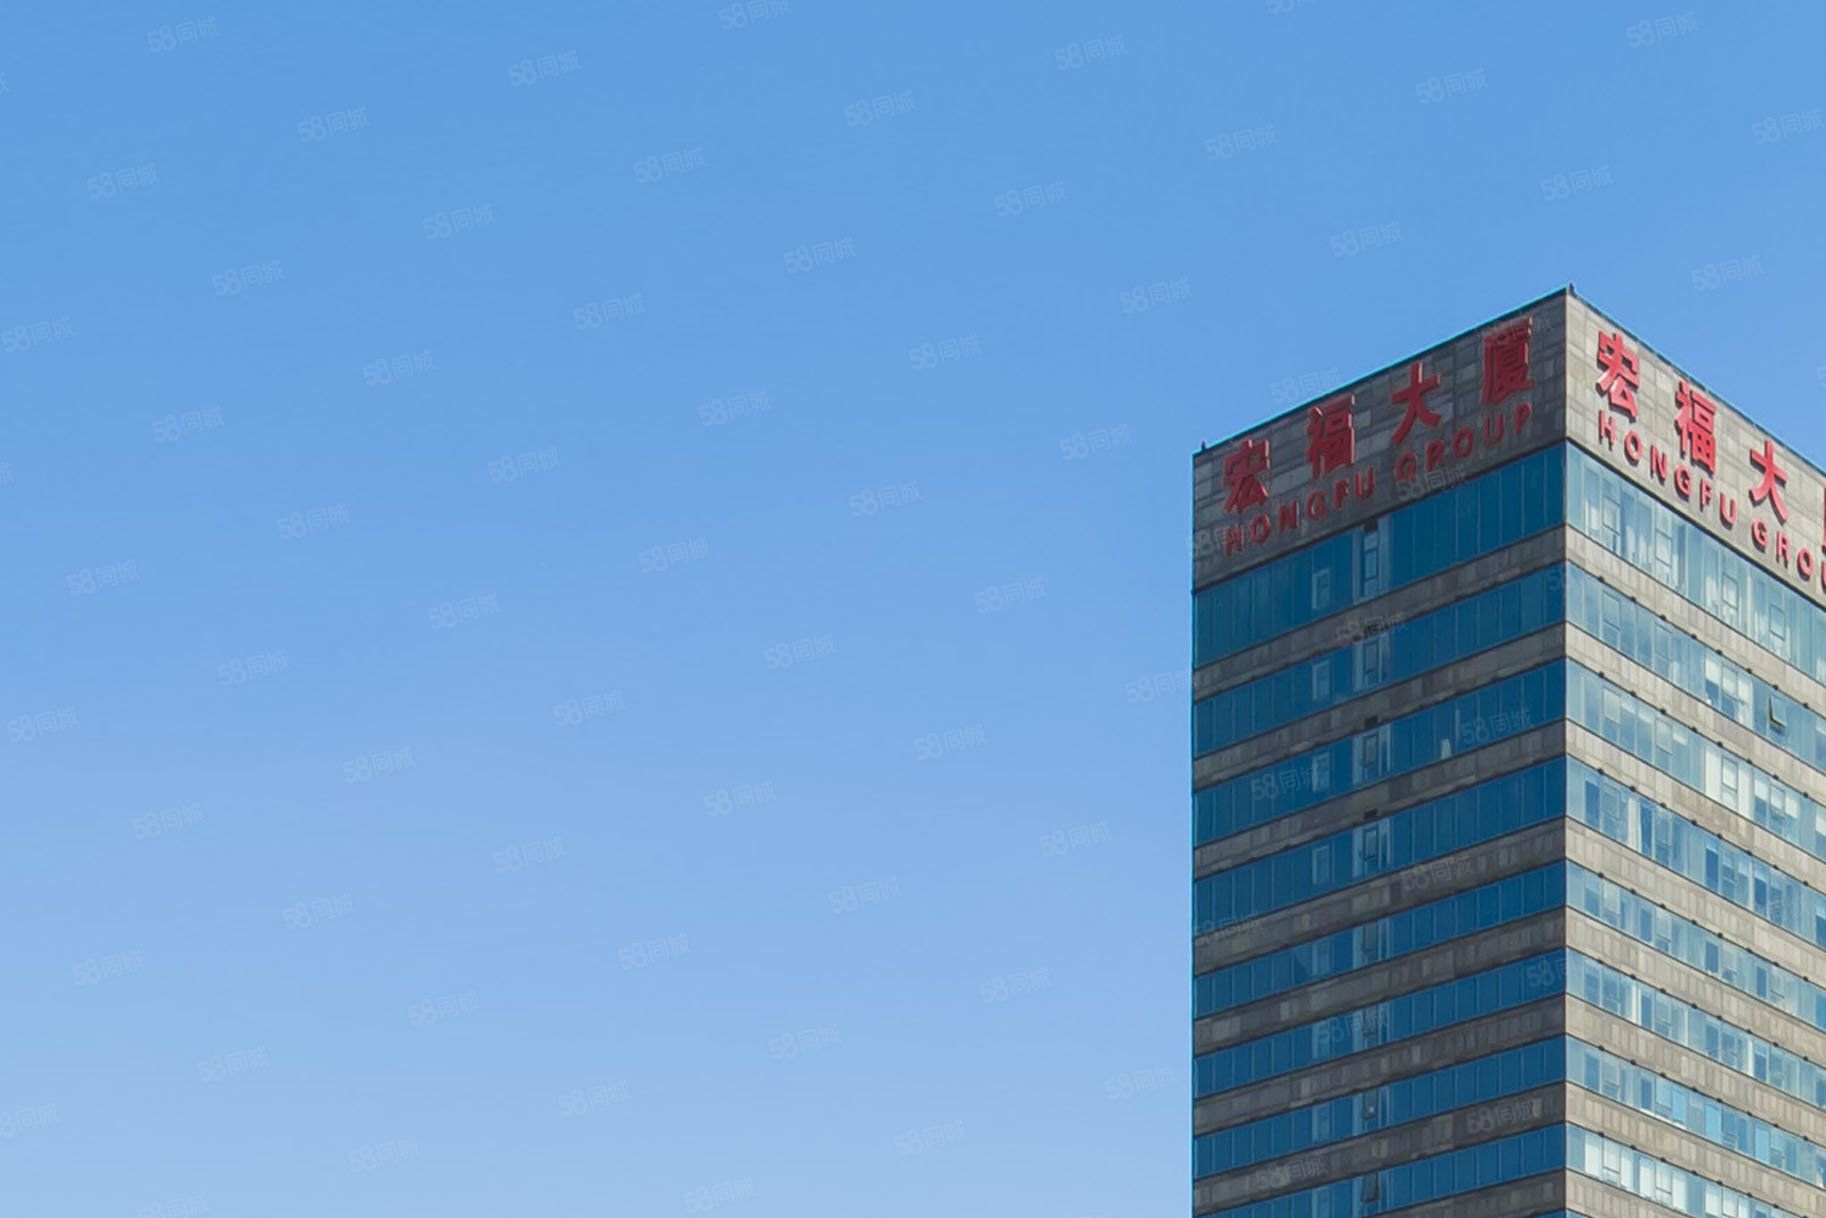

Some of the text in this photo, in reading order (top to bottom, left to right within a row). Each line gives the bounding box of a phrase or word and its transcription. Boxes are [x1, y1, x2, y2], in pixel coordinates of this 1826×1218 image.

[1223, 316, 1534, 513] 宏福大厦
[1225, 402, 1533, 556] HONGFU GROUP
[1598, 410, 1738, 529] HONGFU
